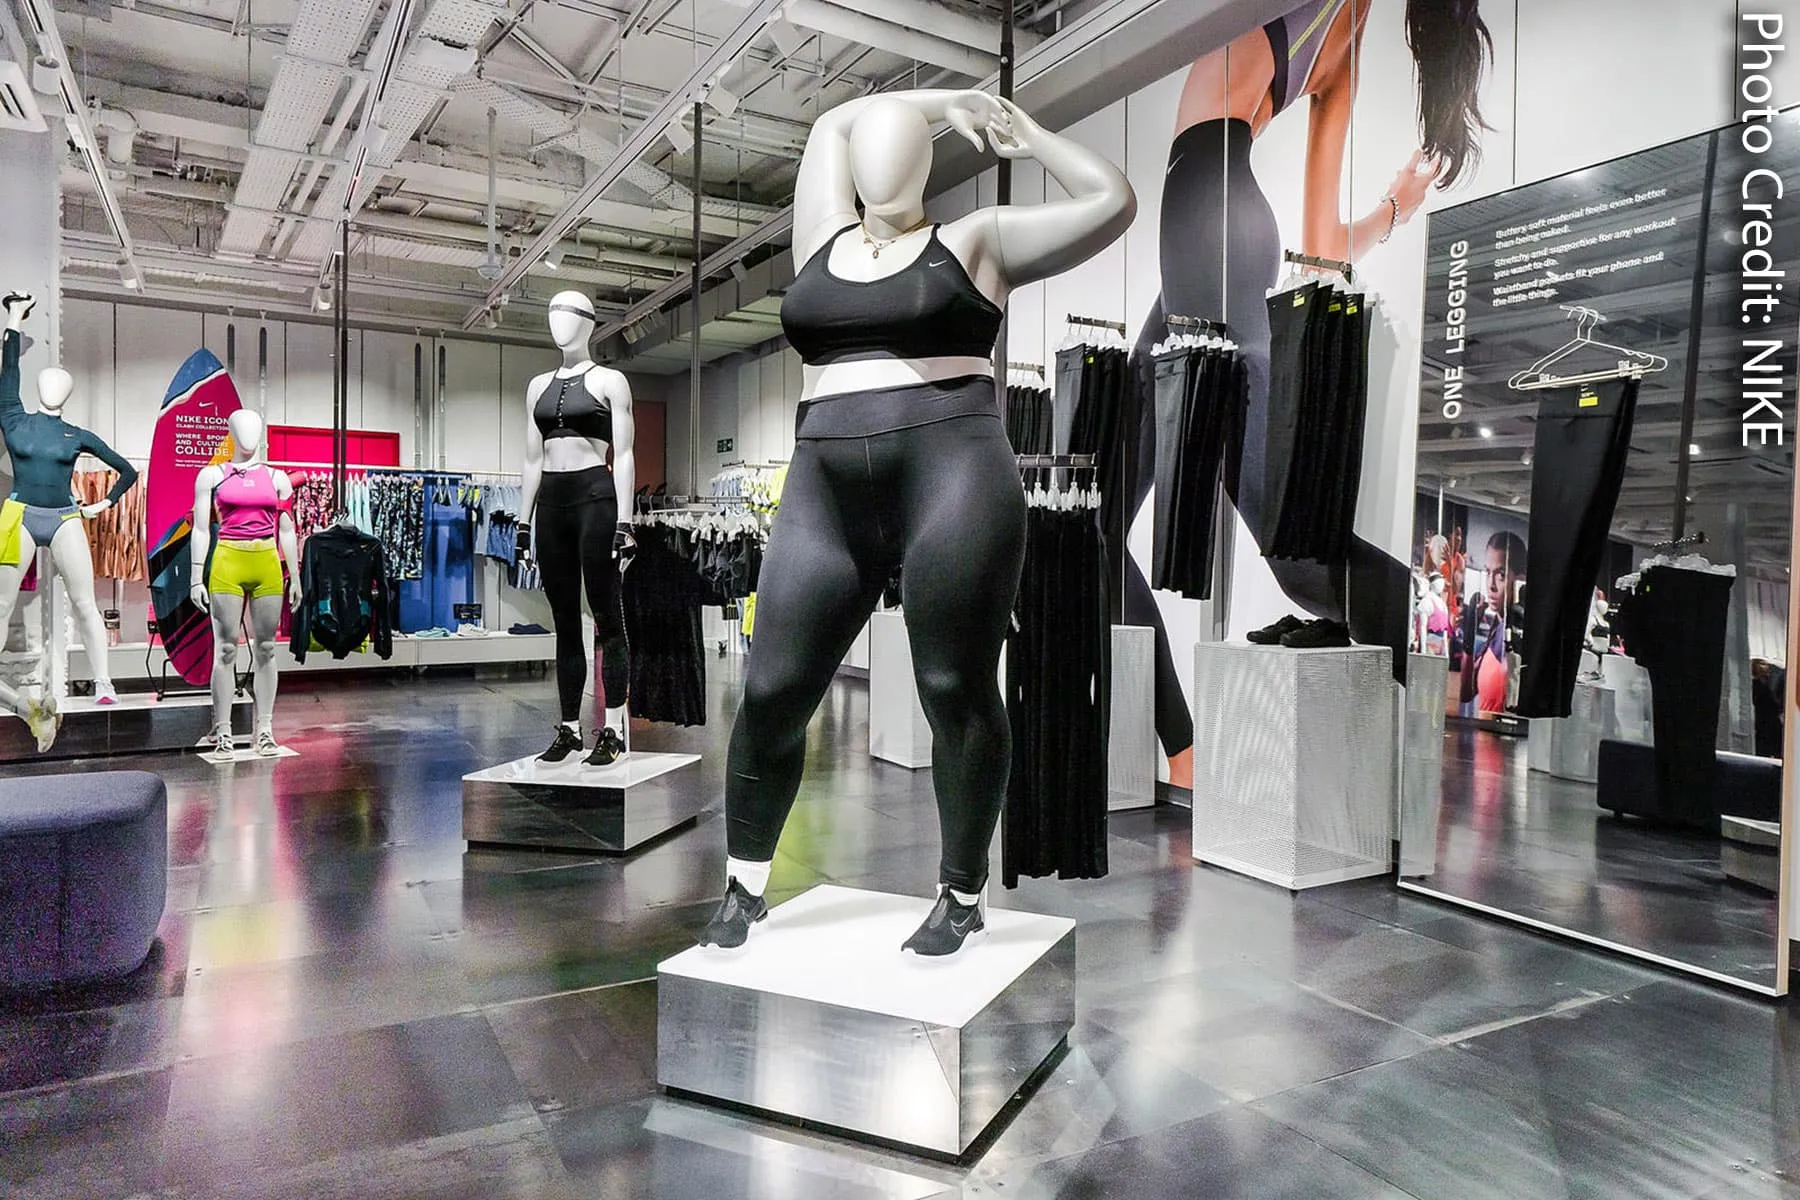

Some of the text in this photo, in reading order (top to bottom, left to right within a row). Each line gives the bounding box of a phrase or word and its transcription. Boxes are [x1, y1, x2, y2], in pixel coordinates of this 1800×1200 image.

[1527, 219, 1547, 231] soft
[1634, 189, 1667, 202] better
[1633, 217, 1676, 234] workout
[1443, 240, 1469, 419] ONE LEGGING
[175, 415, 201, 423] NIKE
[175, 446, 229, 456] COLLIDE
